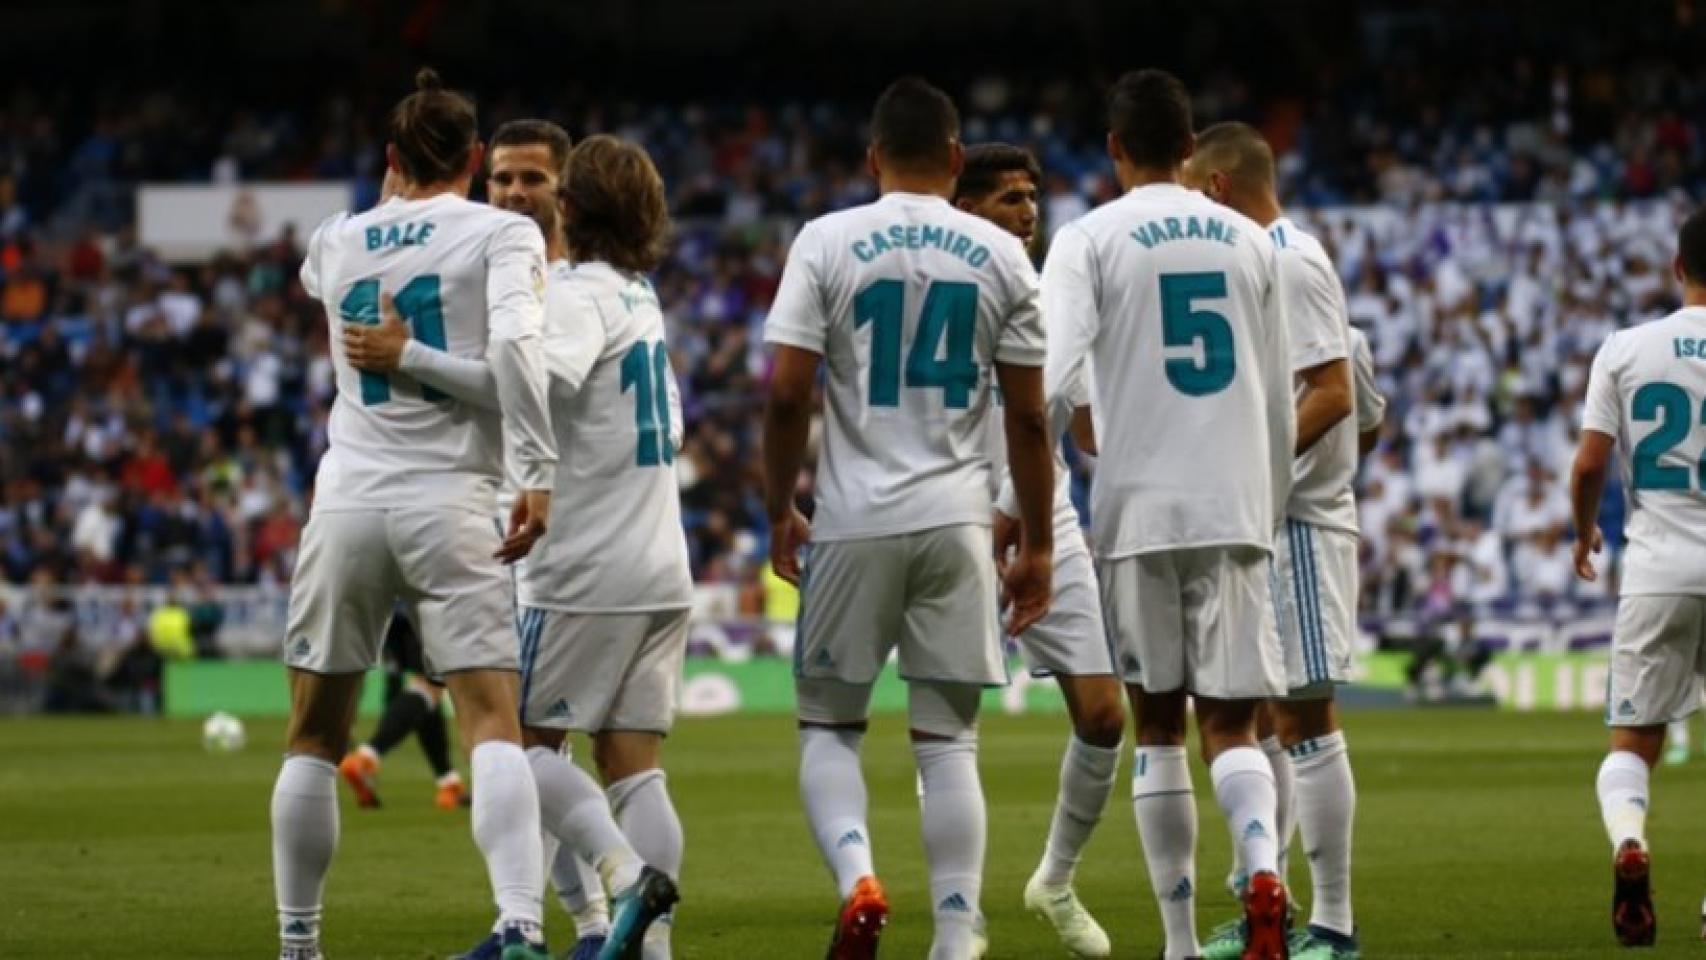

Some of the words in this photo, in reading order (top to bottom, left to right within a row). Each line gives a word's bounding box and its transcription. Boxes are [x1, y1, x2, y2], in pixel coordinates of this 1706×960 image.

[365, 222, 436, 251] BALE
[852, 224, 990, 268] CASEMIRO
[1130, 216, 1239, 248] VARANE
[853, 278, 978, 407] 14
[1159, 271, 1236, 397] 5
[1631, 382, 1706, 490] 2
